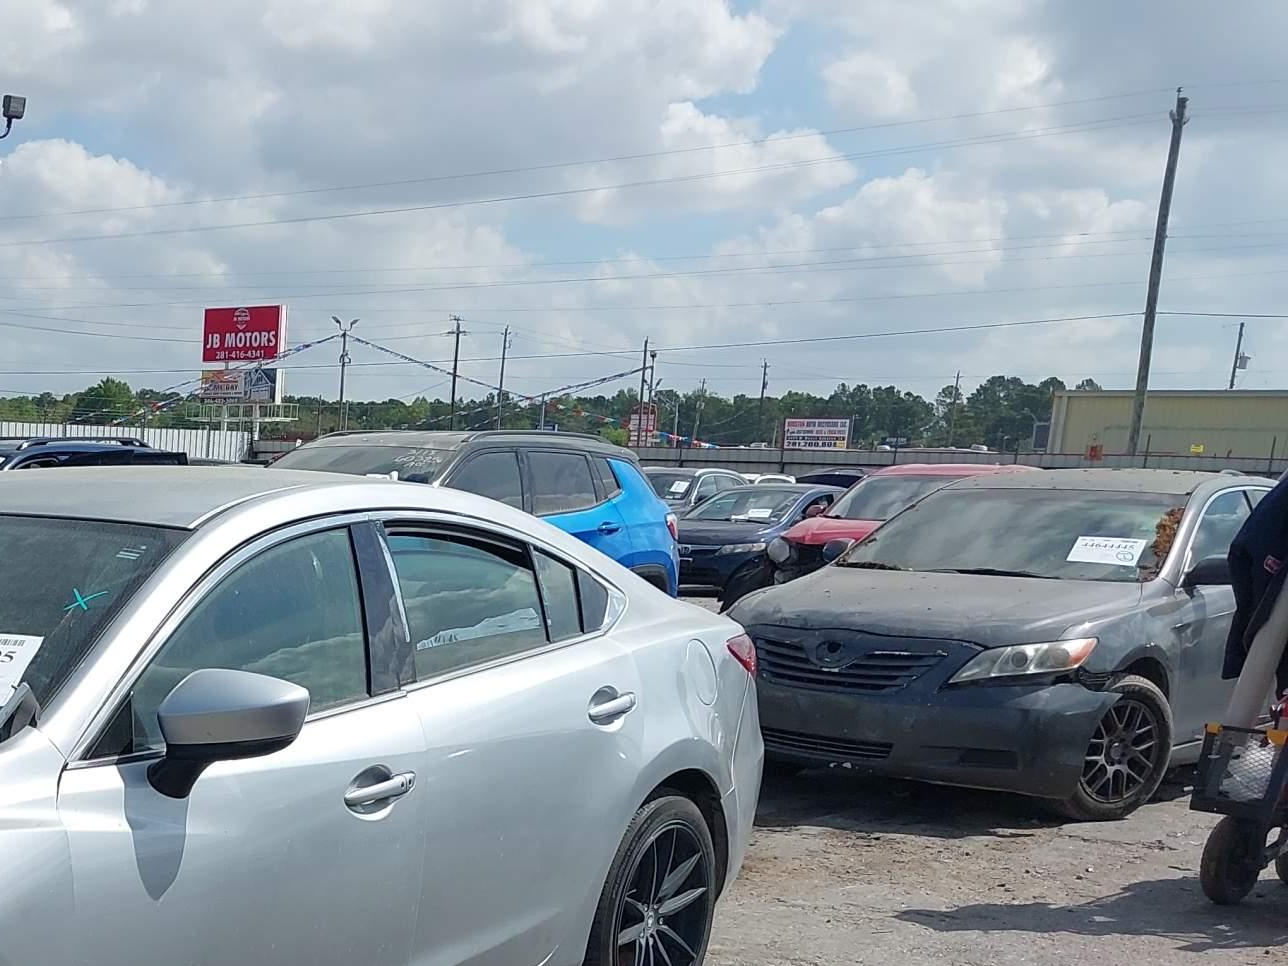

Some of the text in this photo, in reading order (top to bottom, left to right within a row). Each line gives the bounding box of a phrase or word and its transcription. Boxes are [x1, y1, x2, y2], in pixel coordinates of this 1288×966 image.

[206, 331, 276, 349] JB MOTORS
[215, 350, 265, 360] 281-416-4341
